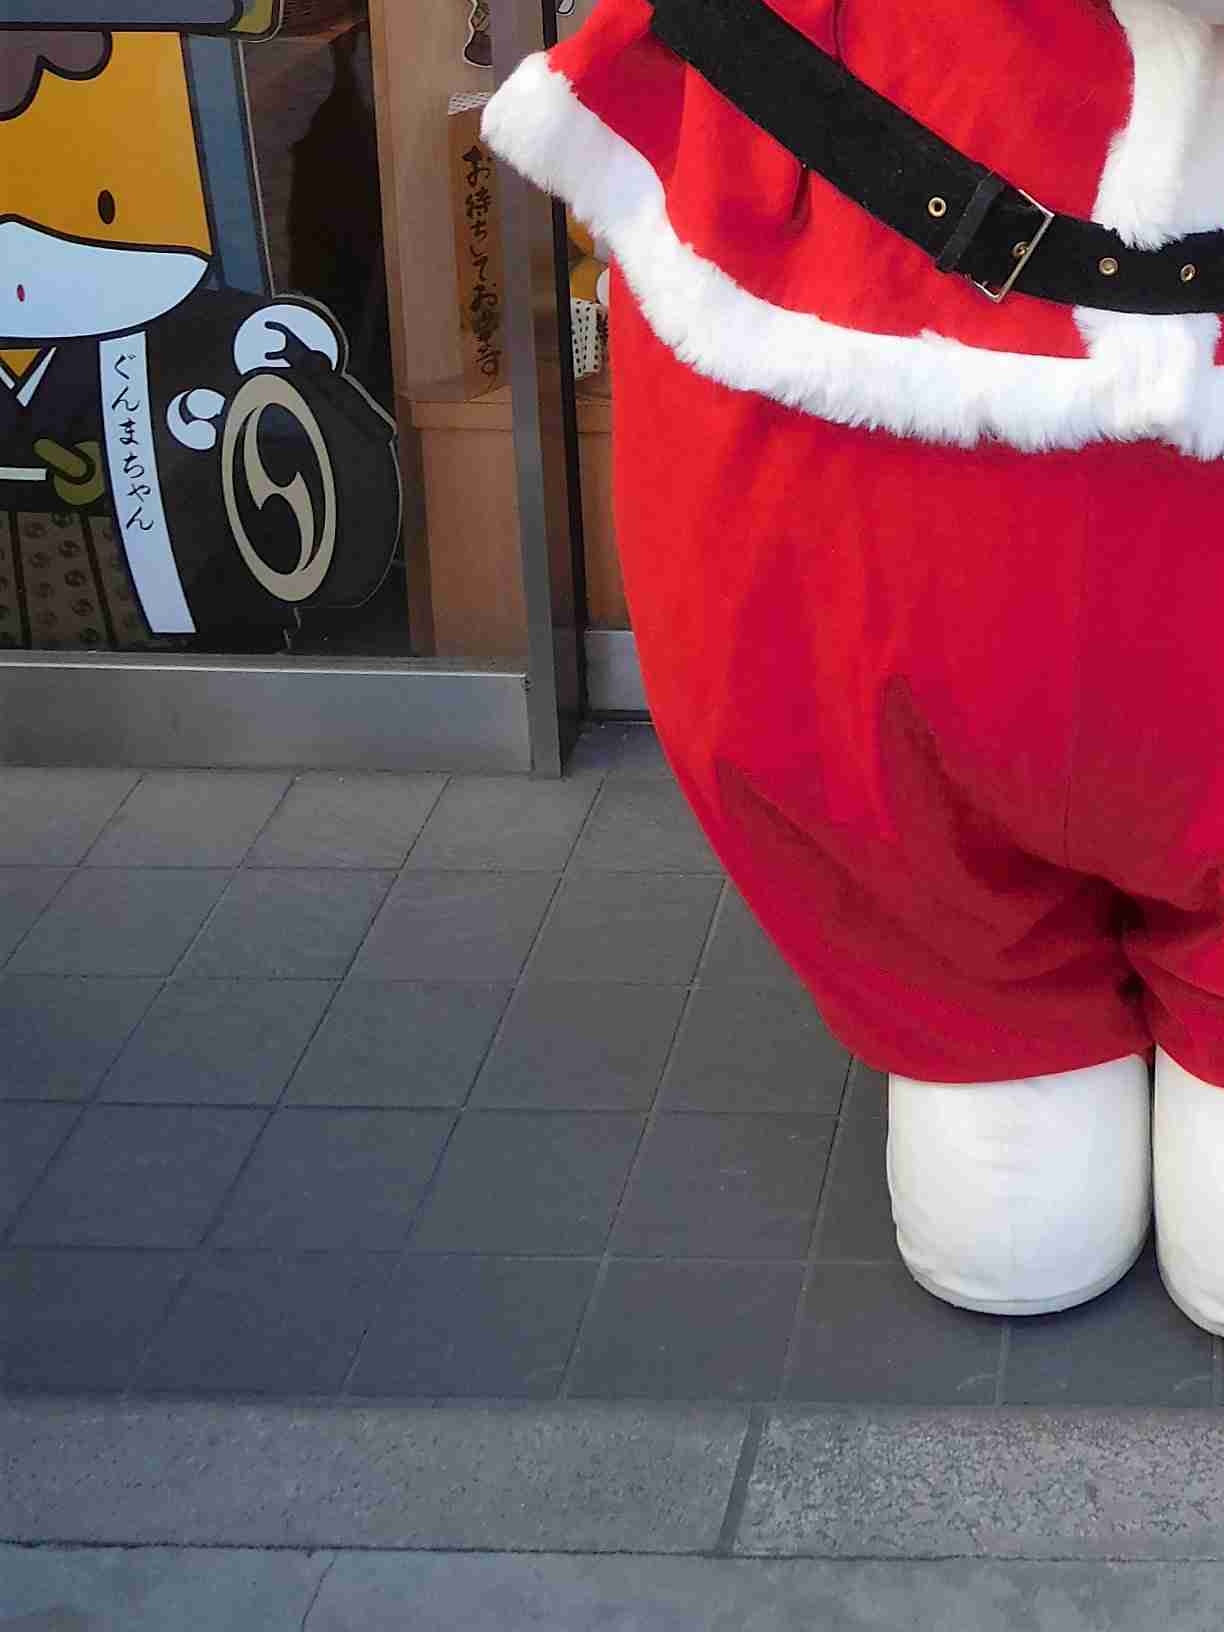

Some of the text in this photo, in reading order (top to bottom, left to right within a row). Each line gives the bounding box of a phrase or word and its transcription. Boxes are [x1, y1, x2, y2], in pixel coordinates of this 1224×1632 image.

[111, 352, 154, 532] ぐんまちゃん
